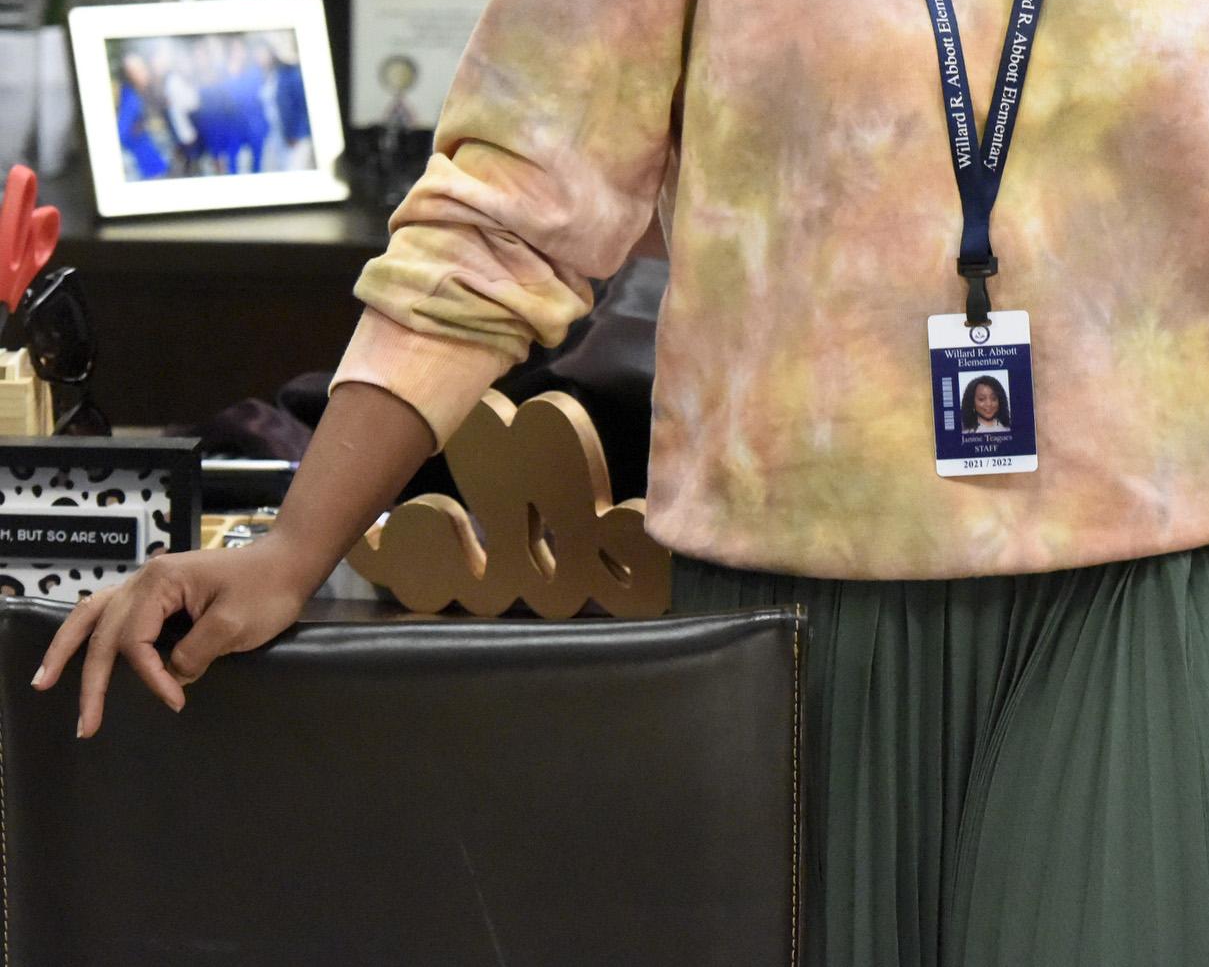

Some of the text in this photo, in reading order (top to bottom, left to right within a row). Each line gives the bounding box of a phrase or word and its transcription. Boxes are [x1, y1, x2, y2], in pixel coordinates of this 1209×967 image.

[1016, 12, 1034, 29] R.
[942, 37, 962, 87] Abbott
[1005, 31, 1029, 83] Abbott
[949, 91, 965, 109] R.
[983, 85, 1019, 171] Elementary
[952, 112, 973, 170] Willard
[944, 346, 1017, 359] Willard R. Abbott
[958, 357, 1005, 367] Elementary
[975, 444, 999, 453] STAFF
[964, 459, 984, 469] 2021
[993, 457, 1013, 467] 2022
[17, 528, 44, 542] BUT
[46, 530, 67, 542] SO
[70, 531, 97, 544] ARE
[100, 532, 130, 544] YOU
